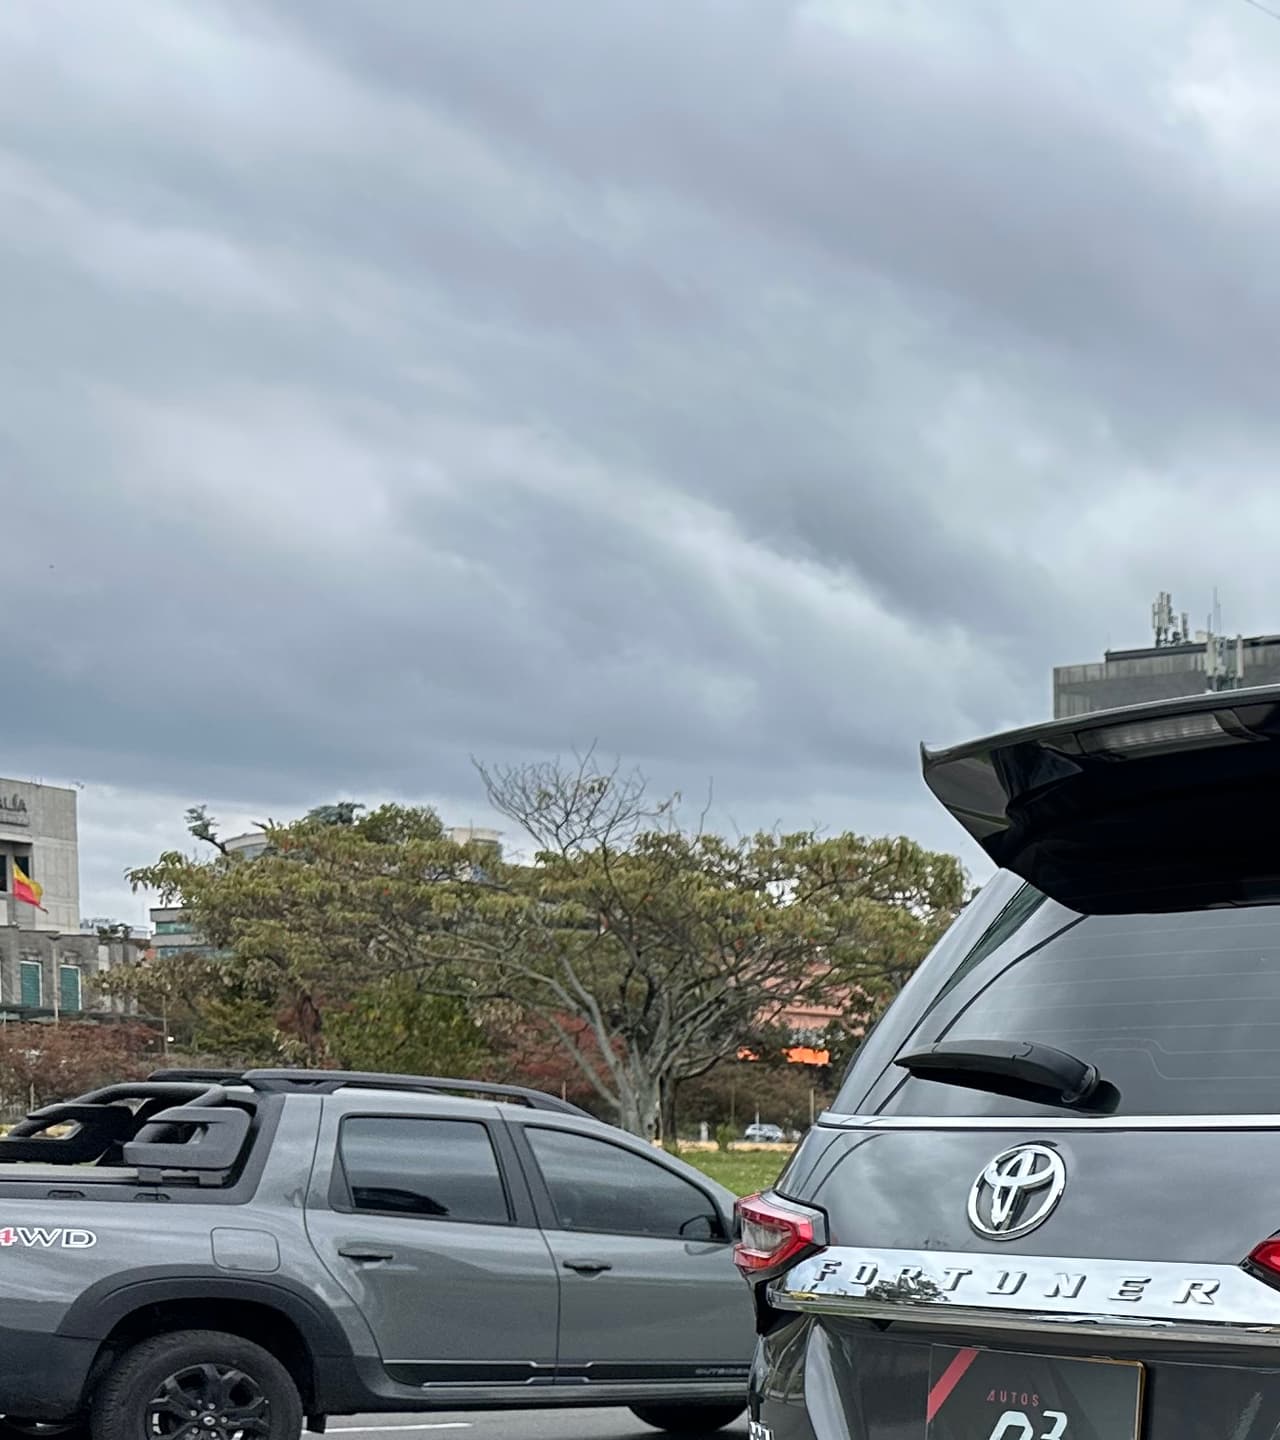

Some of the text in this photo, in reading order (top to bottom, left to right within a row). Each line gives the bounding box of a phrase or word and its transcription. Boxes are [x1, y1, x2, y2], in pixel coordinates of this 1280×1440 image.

[0, 1227, 97, 1248] 4WD
[813, 1258, 1221, 1305] FORTUNER
[986, 1389, 1040, 1407] AUTOS
